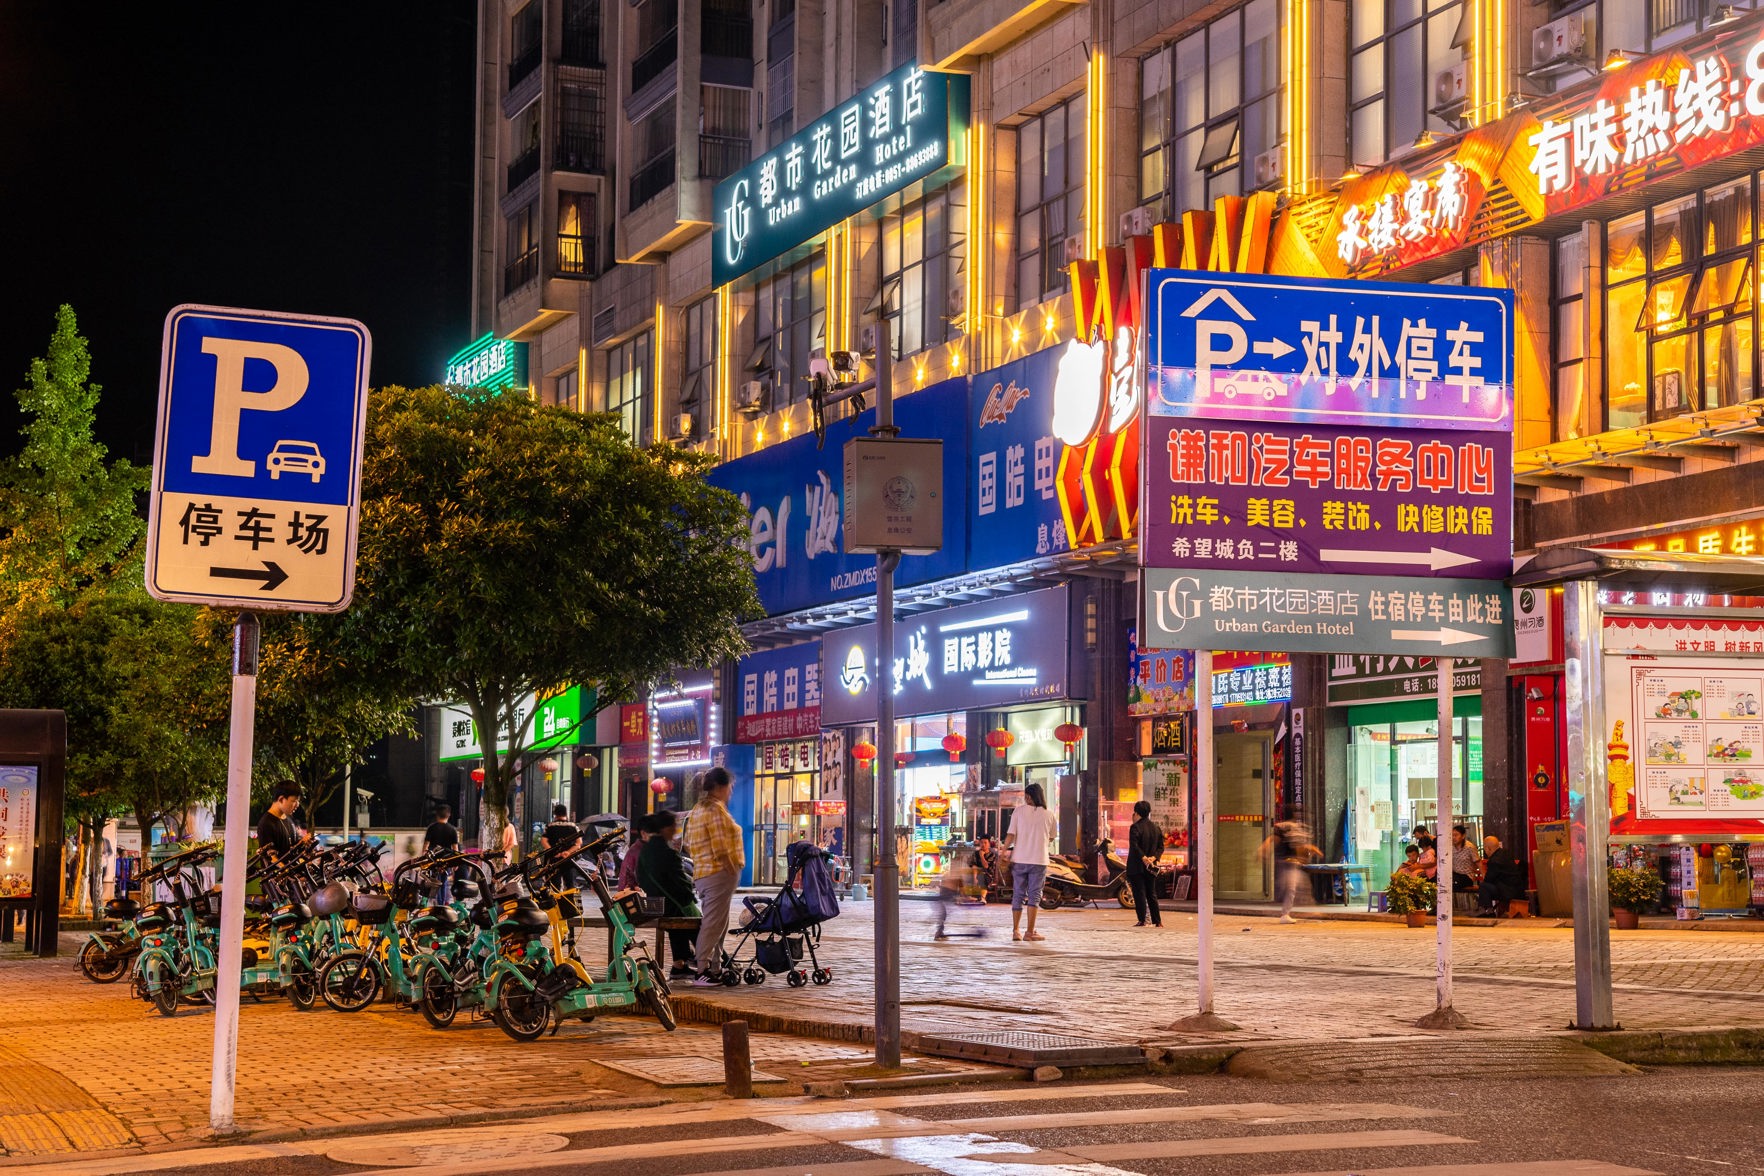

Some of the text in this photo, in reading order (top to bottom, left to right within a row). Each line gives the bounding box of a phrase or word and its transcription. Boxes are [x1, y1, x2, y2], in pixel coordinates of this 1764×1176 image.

[759, 67, 924, 208] 都市花园酒店
[768, 124, 912, 226] Urban Garden Hotel
[1300, 313, 1485, 404] 对外停车
[191, 336, 310, 478] P
[1167, 429, 1495, 495] 谦和汽车服务中心
[178, 502, 330, 555] 停车场
[1170, 494, 1494, 536] 洗车、美容、装饰、快修快保
[1171, 536, 1299, 563] 希望城负二楼
[1208, 584, 1504, 626] 都市花园酒店 住宿停车由此进
[1214, 618, 1355, 636] Urban Garden Hotel
[943, 628, 1012, 675] 国际影院
[1140, 655, 1184, 686] 平价店
[623, 711, 643, 736] 一单元
[1154, 720, 1181, 748] 烟酒
[765, 742, 820, 769] 国皓电
